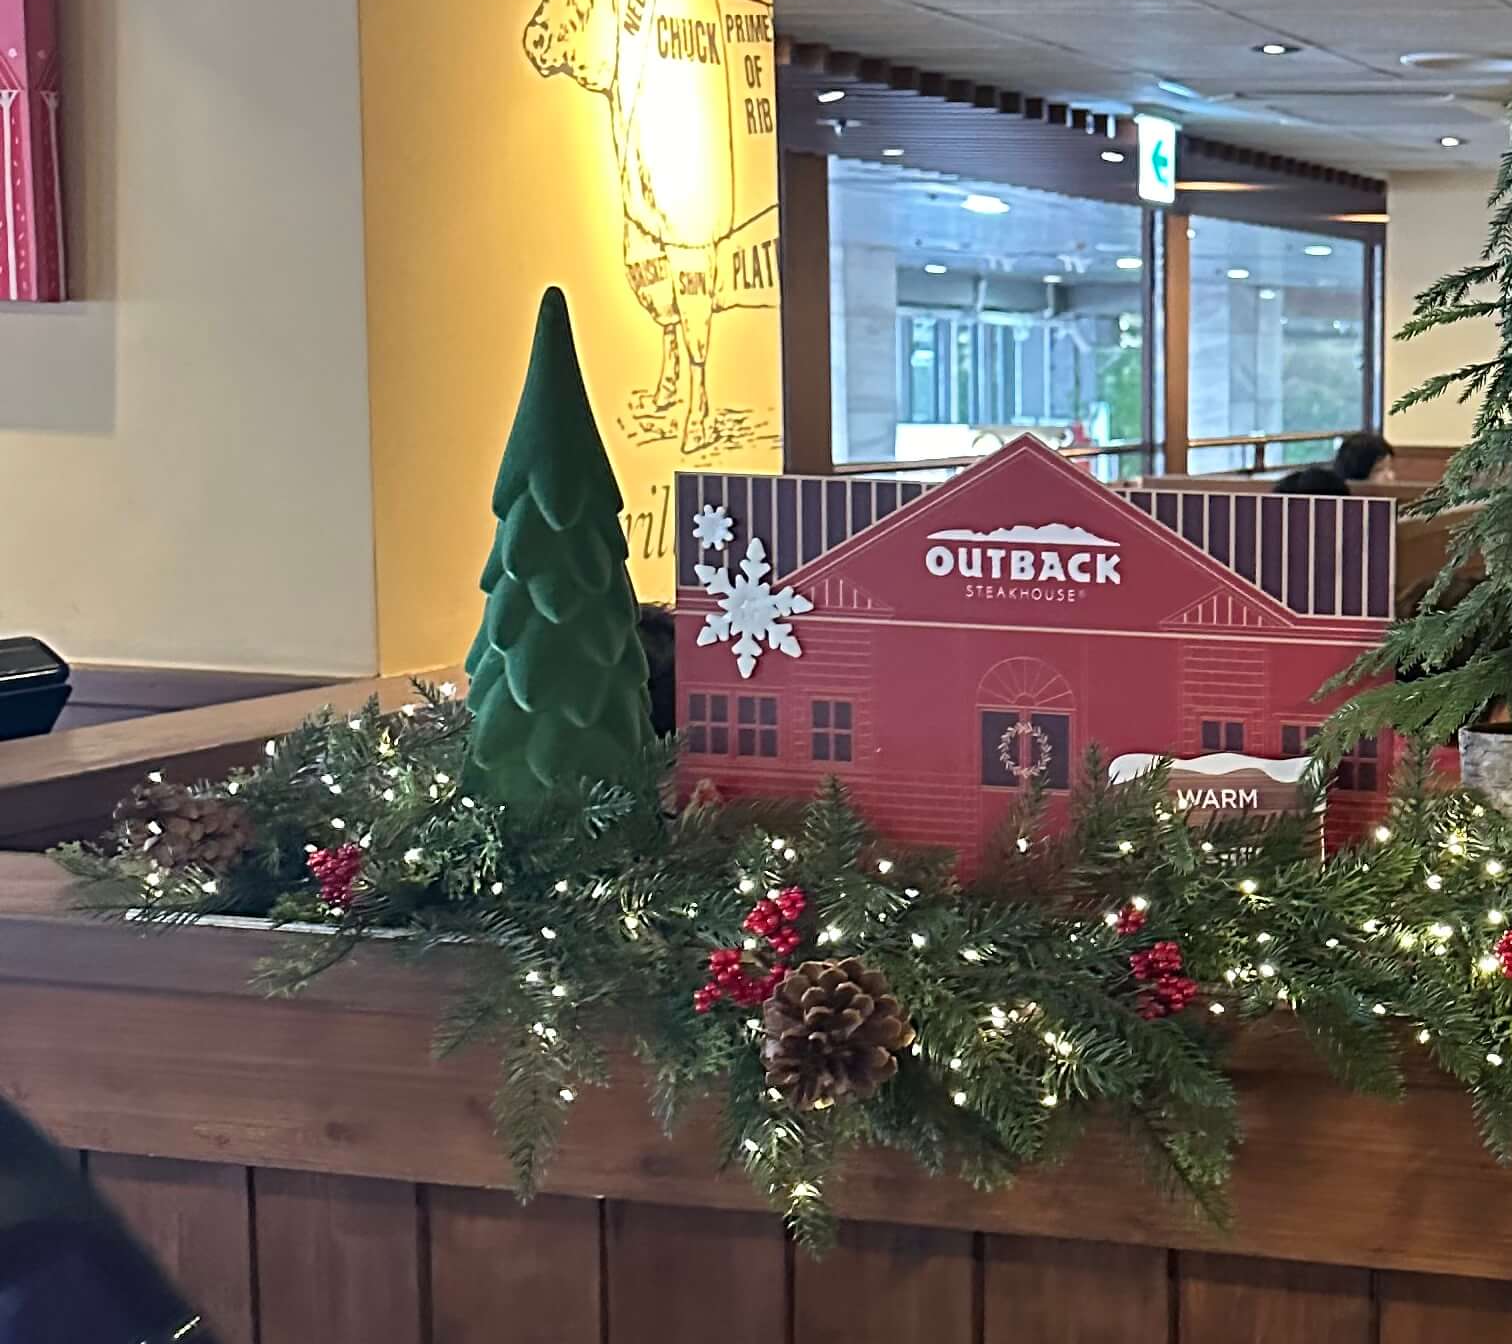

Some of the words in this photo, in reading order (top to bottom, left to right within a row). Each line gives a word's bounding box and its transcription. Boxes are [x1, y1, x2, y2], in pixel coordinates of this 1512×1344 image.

[656, 14, 721, 66] CHUCK
[725, 14, 773, 43] PRIME
[744, 54, 763, 89] OF
[744, 97, 774, 135] RIB
[733, 237, 779, 291] PLAT
[925, 545, 1121, 585] OUTBACK
[966, 584, 1076, 602] STEAKHOUSE
[1177, 788, 1259, 809] WARM
